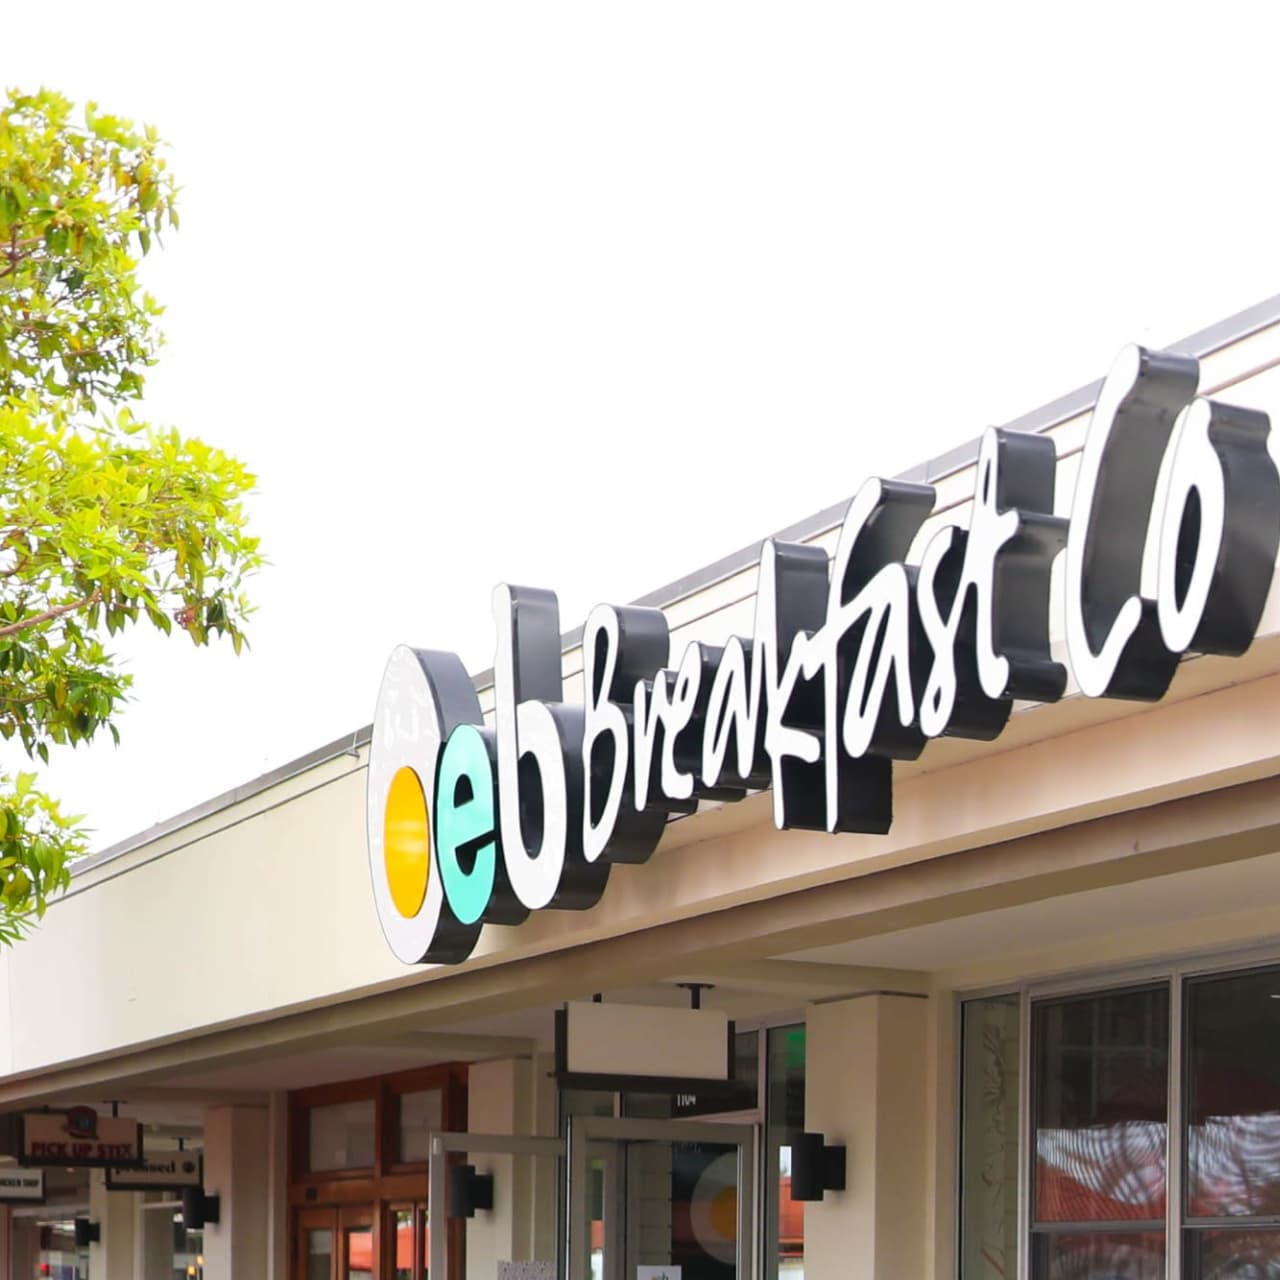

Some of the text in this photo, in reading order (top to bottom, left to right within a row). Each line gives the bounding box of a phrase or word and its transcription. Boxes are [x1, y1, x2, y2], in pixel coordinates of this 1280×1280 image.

[1065, 343, 1225, 698] Co
[31, 1142, 67, 1157] PICK
[72, 1143, 93, 1157] UP
